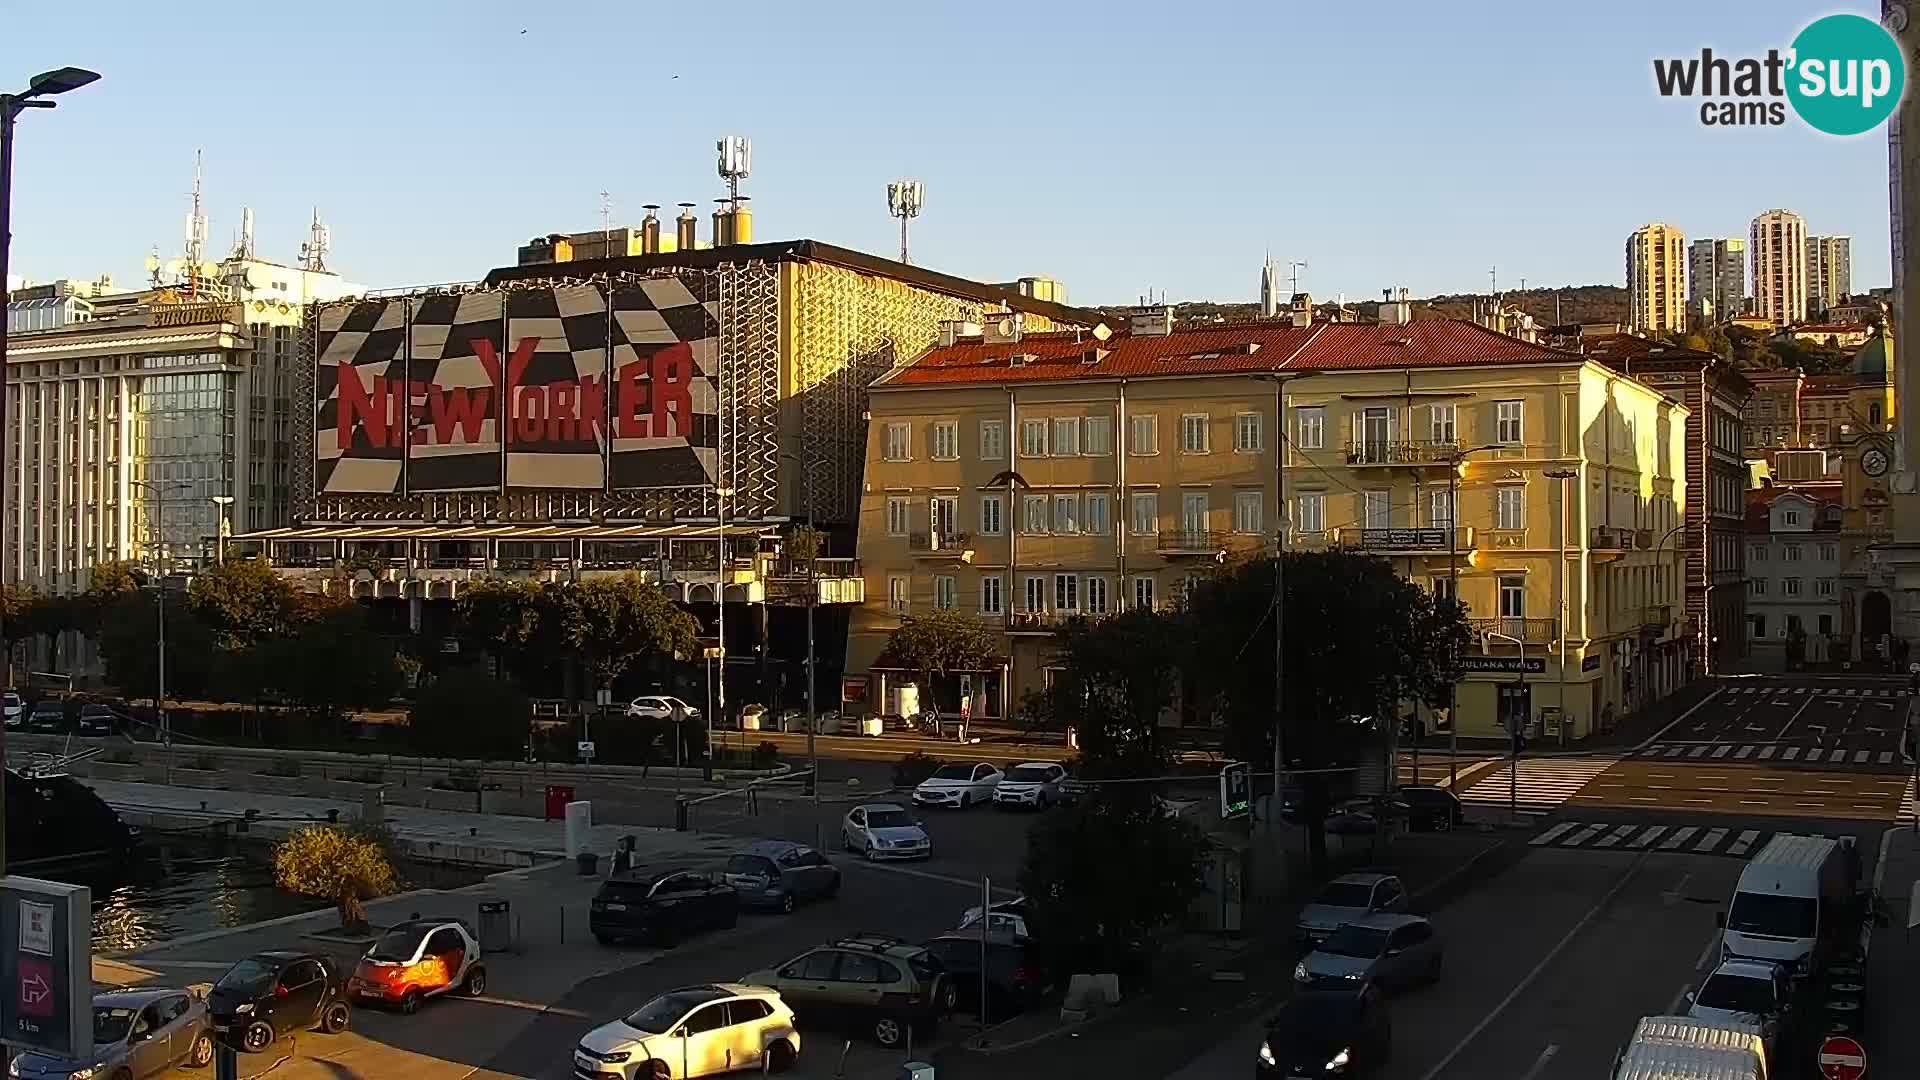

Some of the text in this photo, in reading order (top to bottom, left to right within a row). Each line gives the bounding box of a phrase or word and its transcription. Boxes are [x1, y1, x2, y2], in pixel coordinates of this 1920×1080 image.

[337, 336, 694, 449] NEW YORKER
[1459, 660, 1540, 670] JULIANA NAILS
[19, 1018, 40, 1032] 5 km
